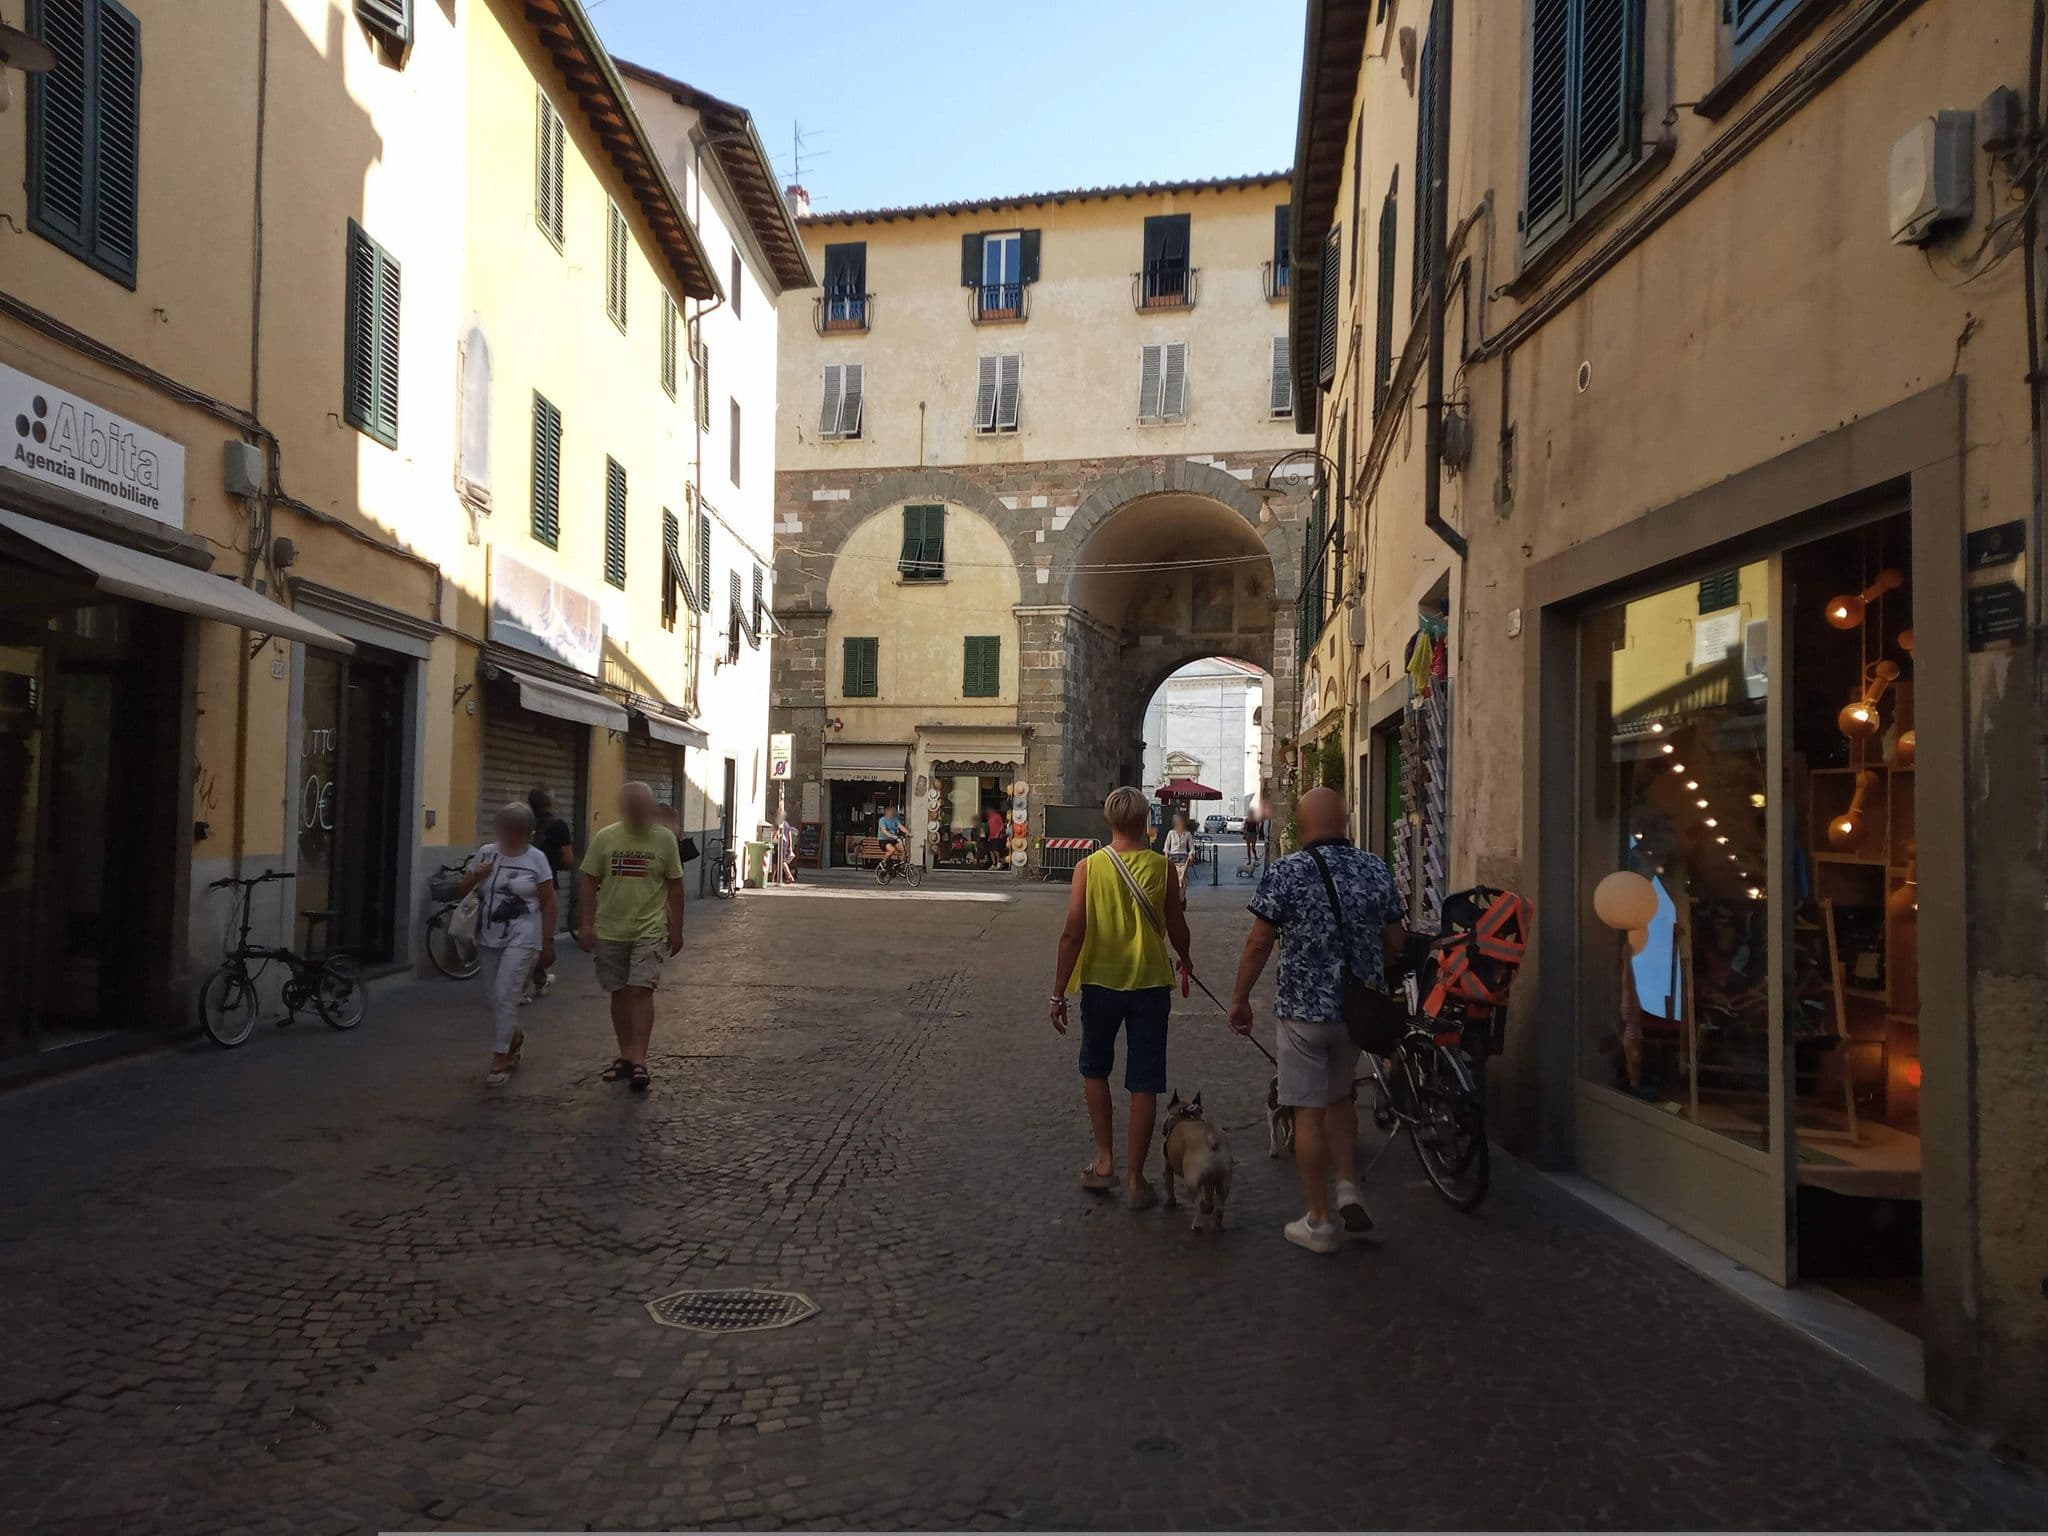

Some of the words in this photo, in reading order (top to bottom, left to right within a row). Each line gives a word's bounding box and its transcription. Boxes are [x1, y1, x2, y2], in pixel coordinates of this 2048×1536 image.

[15, 443, 76, 481] Agenzia
[80, 466, 160, 510] Immobiliare
[50, 401, 159, 491] Abita
